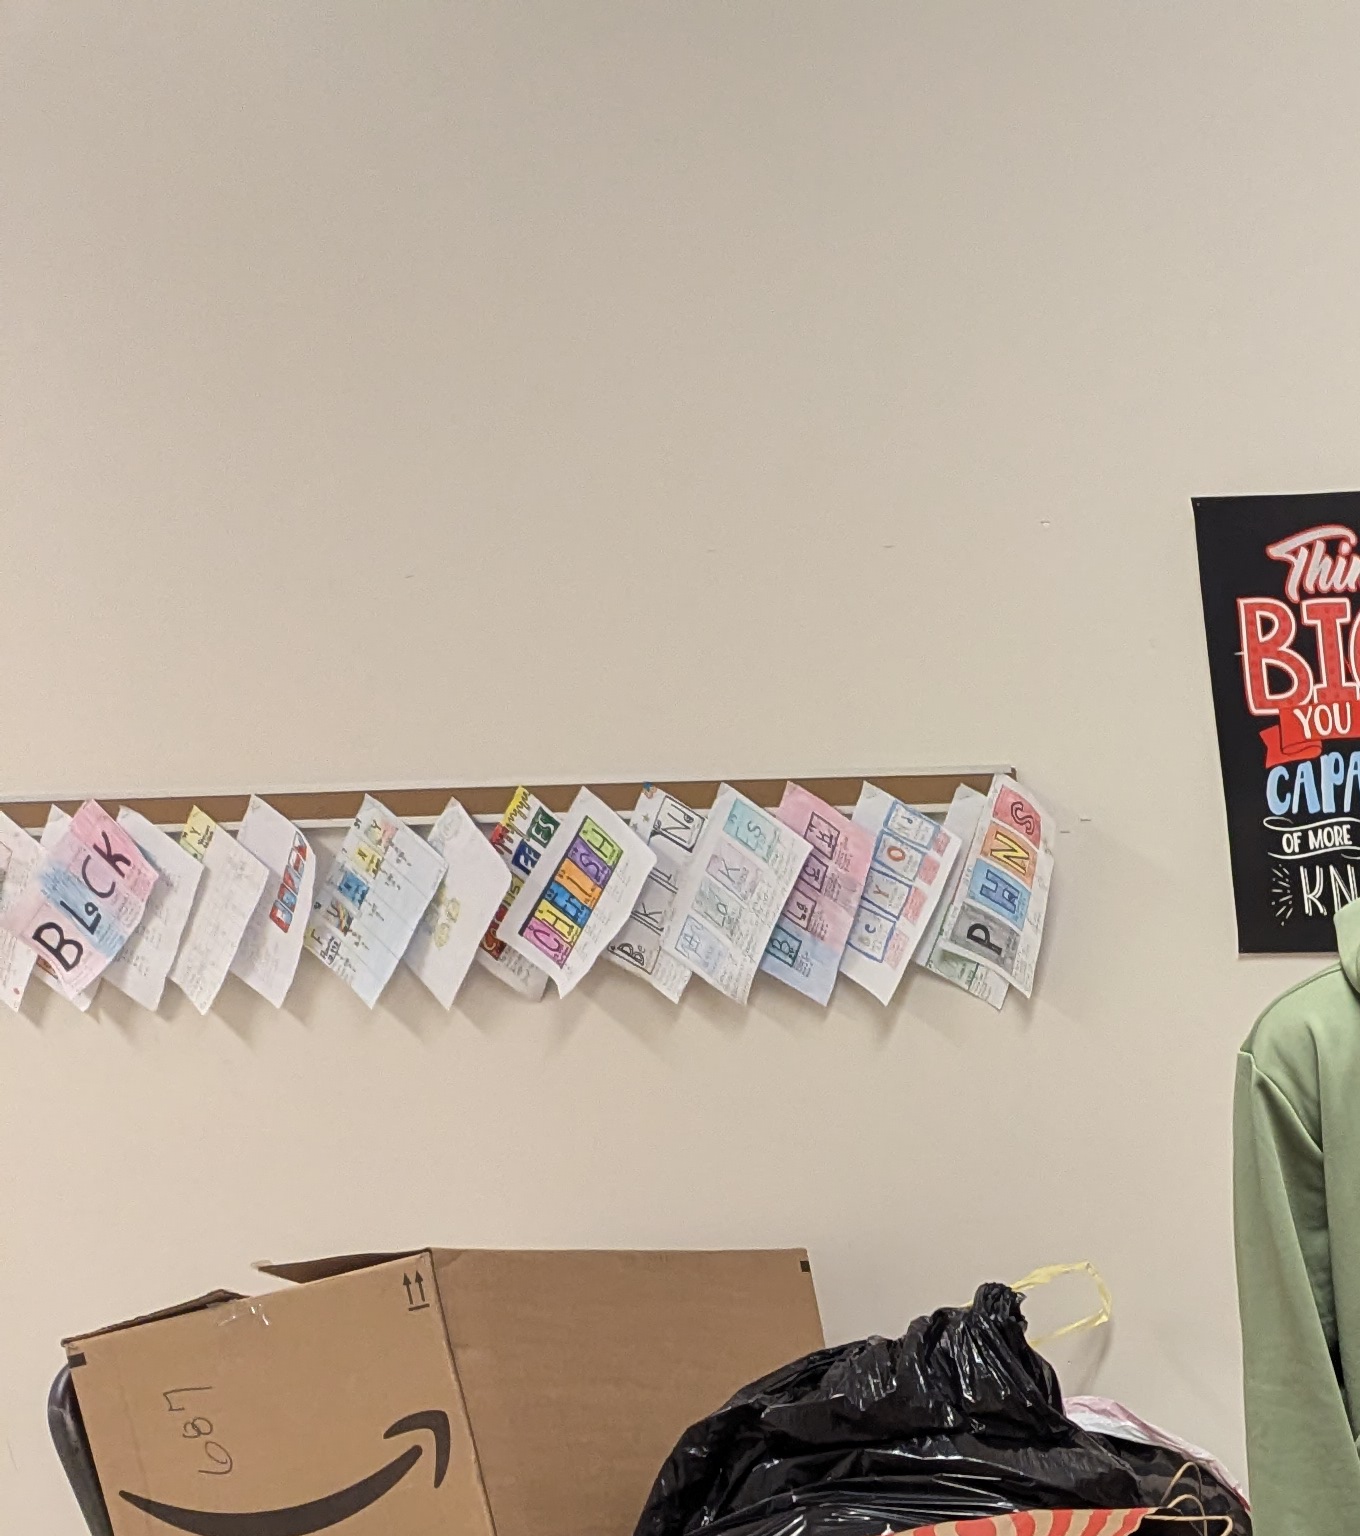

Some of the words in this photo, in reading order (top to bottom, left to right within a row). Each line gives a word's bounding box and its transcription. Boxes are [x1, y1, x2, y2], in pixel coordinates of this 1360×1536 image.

[1294, 702, 1352, 740] YOU
[1282, 829, 1302, 853] OF
[1308, 823, 1353, 850] MORE
